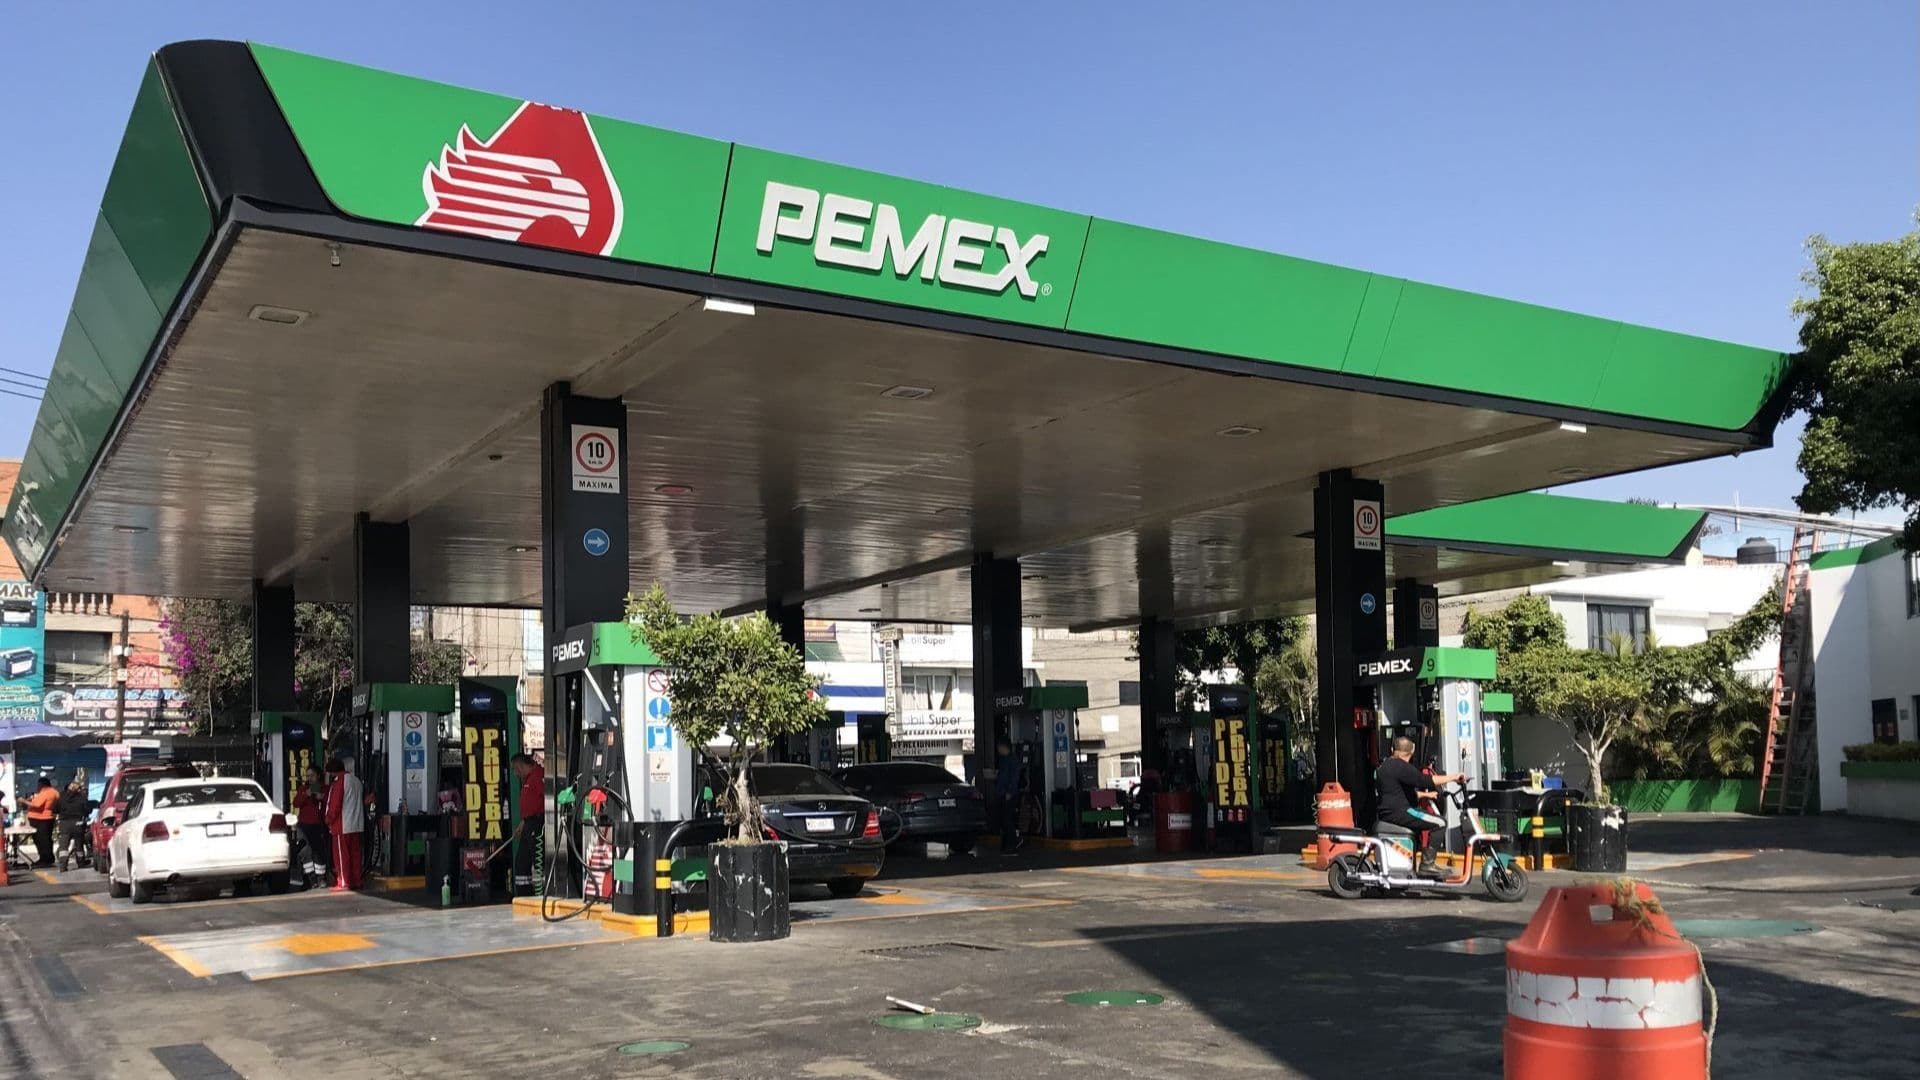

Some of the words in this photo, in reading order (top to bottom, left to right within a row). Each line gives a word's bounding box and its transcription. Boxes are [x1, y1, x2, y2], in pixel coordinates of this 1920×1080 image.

[756, 181, 1049, 297] PEMEX
[587, 441, 605, 458] 10
[579, 480, 613, 489] MAXIMA
[1363, 512, 1373, 524] 10
[922, 636, 946, 646] Super
[552, 639, 586, 662] PEMEX
[593, 639, 600, 656] 15
[1359, 659, 1412, 676] PEMEX
[1427, 658, 1435, 672] 9
[995, 694, 1024, 708] PEMEX
[929, 714, 961, 727] Super
[1214, 718, 1230, 806] PIDE
[1229, 719, 1248, 806] PRUEBA
[464, 727, 482, 840] PIDE
[482, 728, 502, 840] PRUEBA
